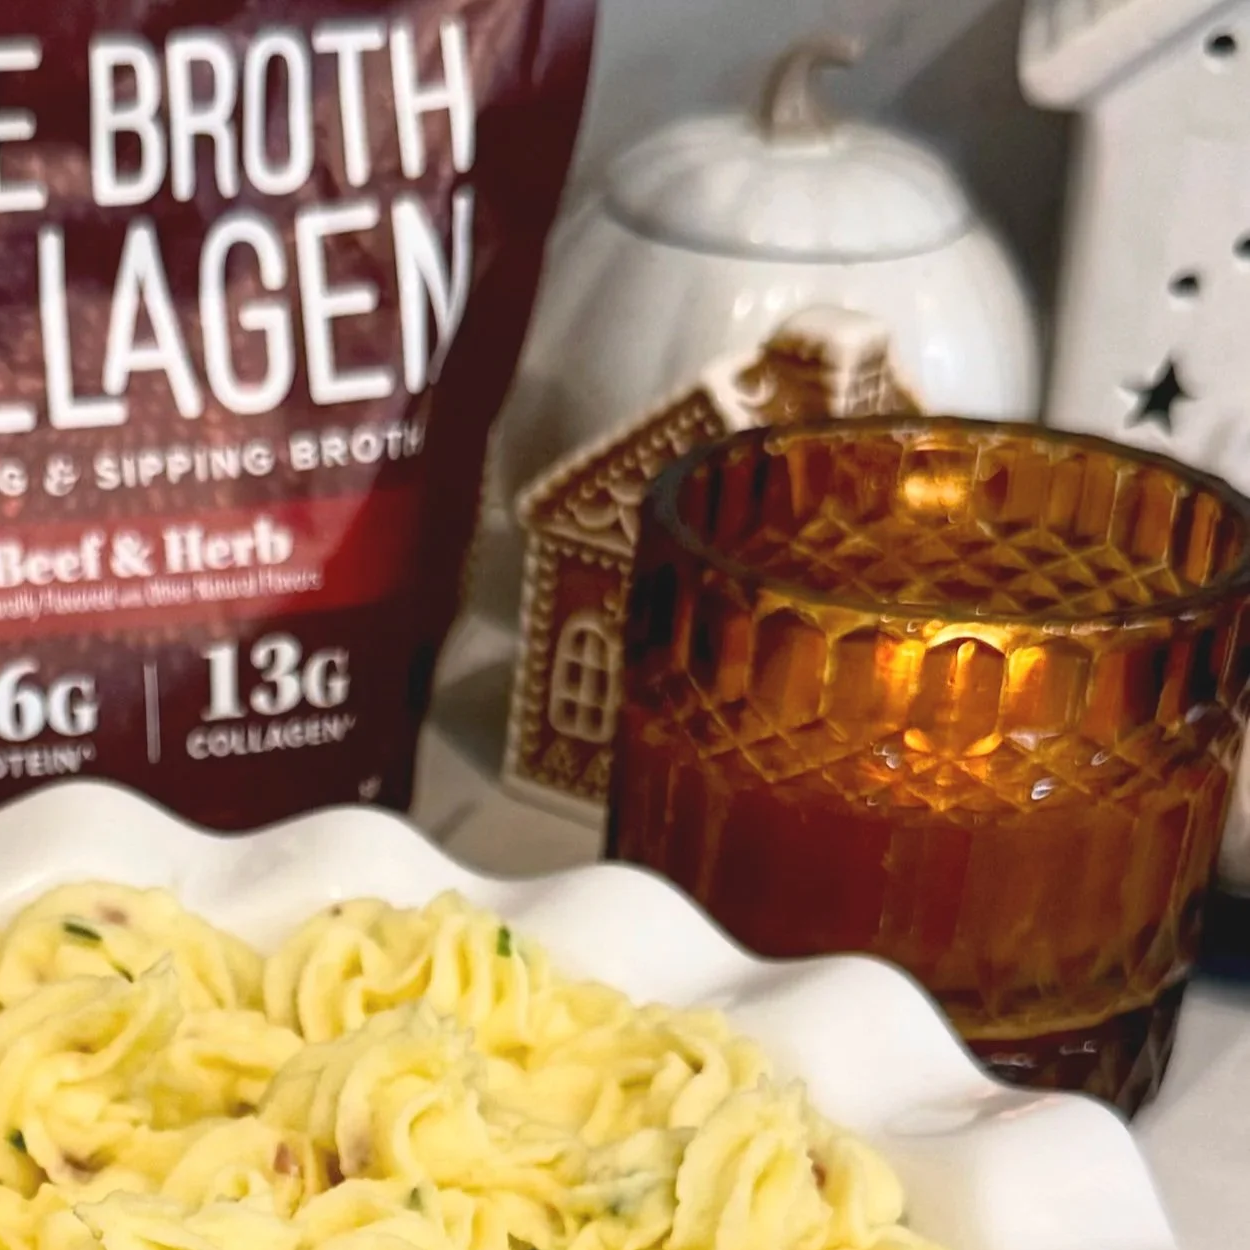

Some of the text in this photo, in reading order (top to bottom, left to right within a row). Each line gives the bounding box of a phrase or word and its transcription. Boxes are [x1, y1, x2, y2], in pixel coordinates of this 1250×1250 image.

[89, 20, 476, 208] BROTH
[42, 453, 80, 497] &
[94, 436, 276, 490] SIPPING
[109, 526, 156, 579] &
[161, 513, 295, 574] Herb
[200, 632, 351, 722] 13G
